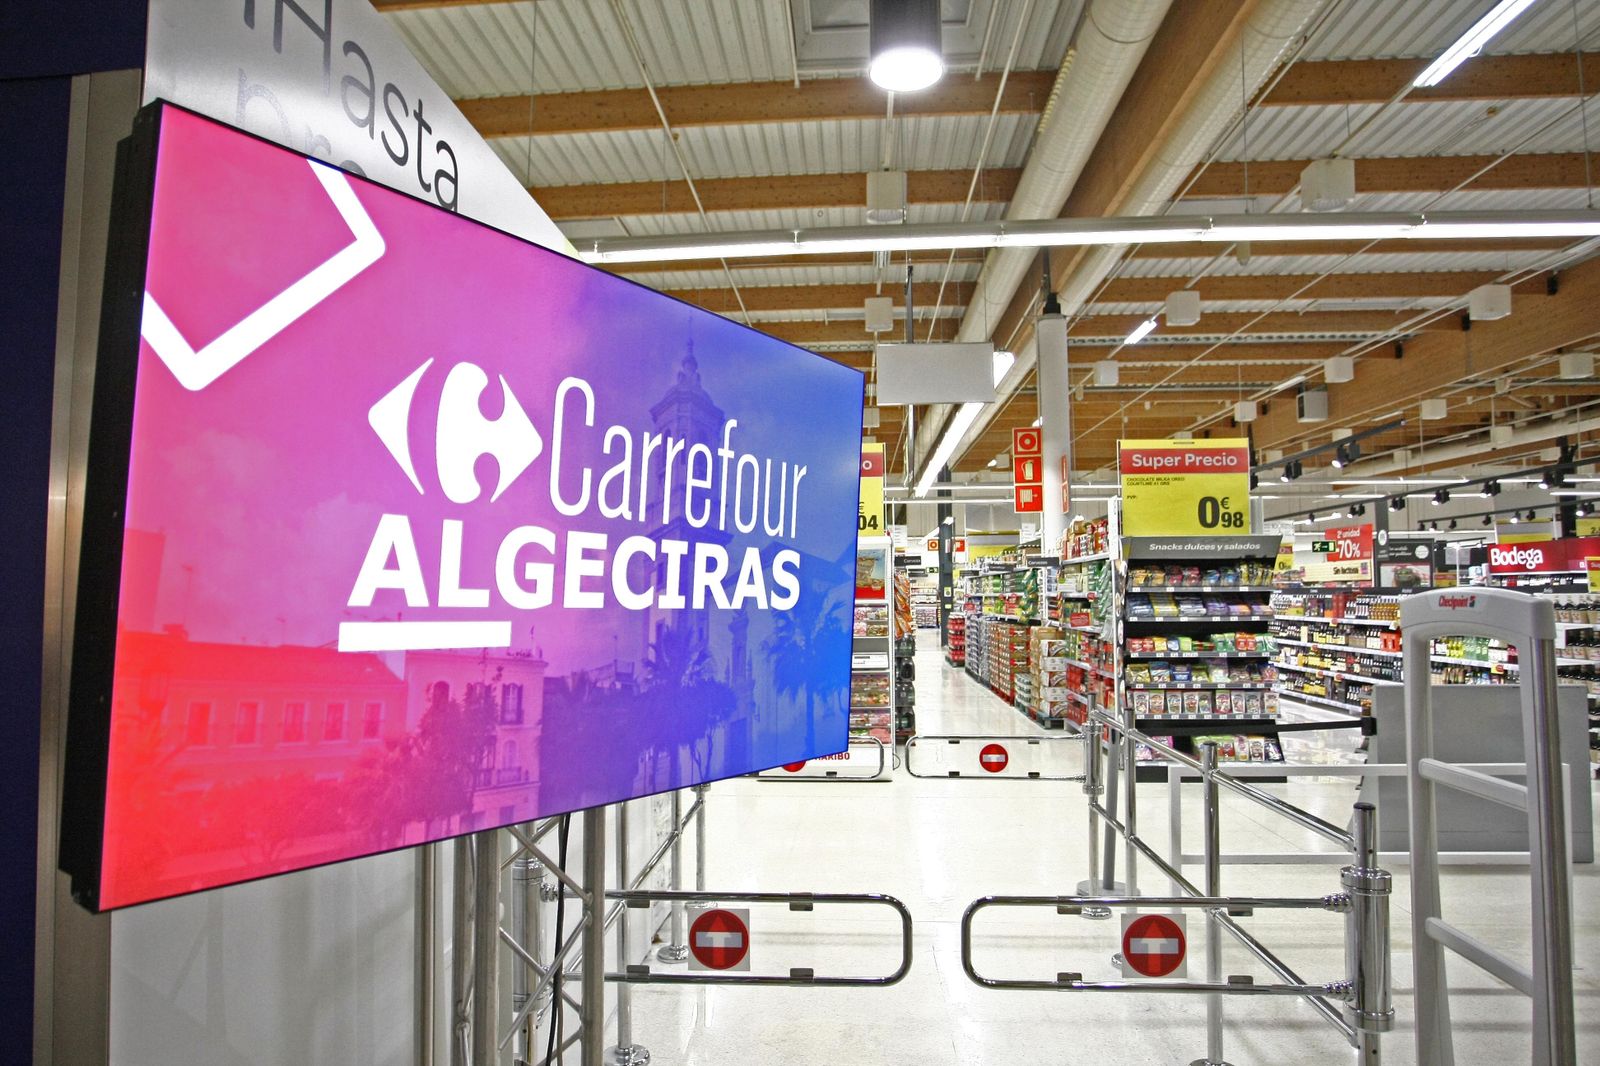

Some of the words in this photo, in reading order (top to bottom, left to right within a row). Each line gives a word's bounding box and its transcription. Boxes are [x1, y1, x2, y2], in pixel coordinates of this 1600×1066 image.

[549, 376, 807, 539] Carrefour
[1132, 453, 1181, 469] Super
[1185, 452, 1237, 466] Precio
[1343, 528, 1360, 538] unidad
[1149, 543, 1182, 551] Snacks
[1184, 543, 1216, 551] dulces
[347, 513, 801, 610] ALGECIRAS
[1490, 546, 1544, 570] Bodega
[1438, 595, 1469, 610] Checkpoint
